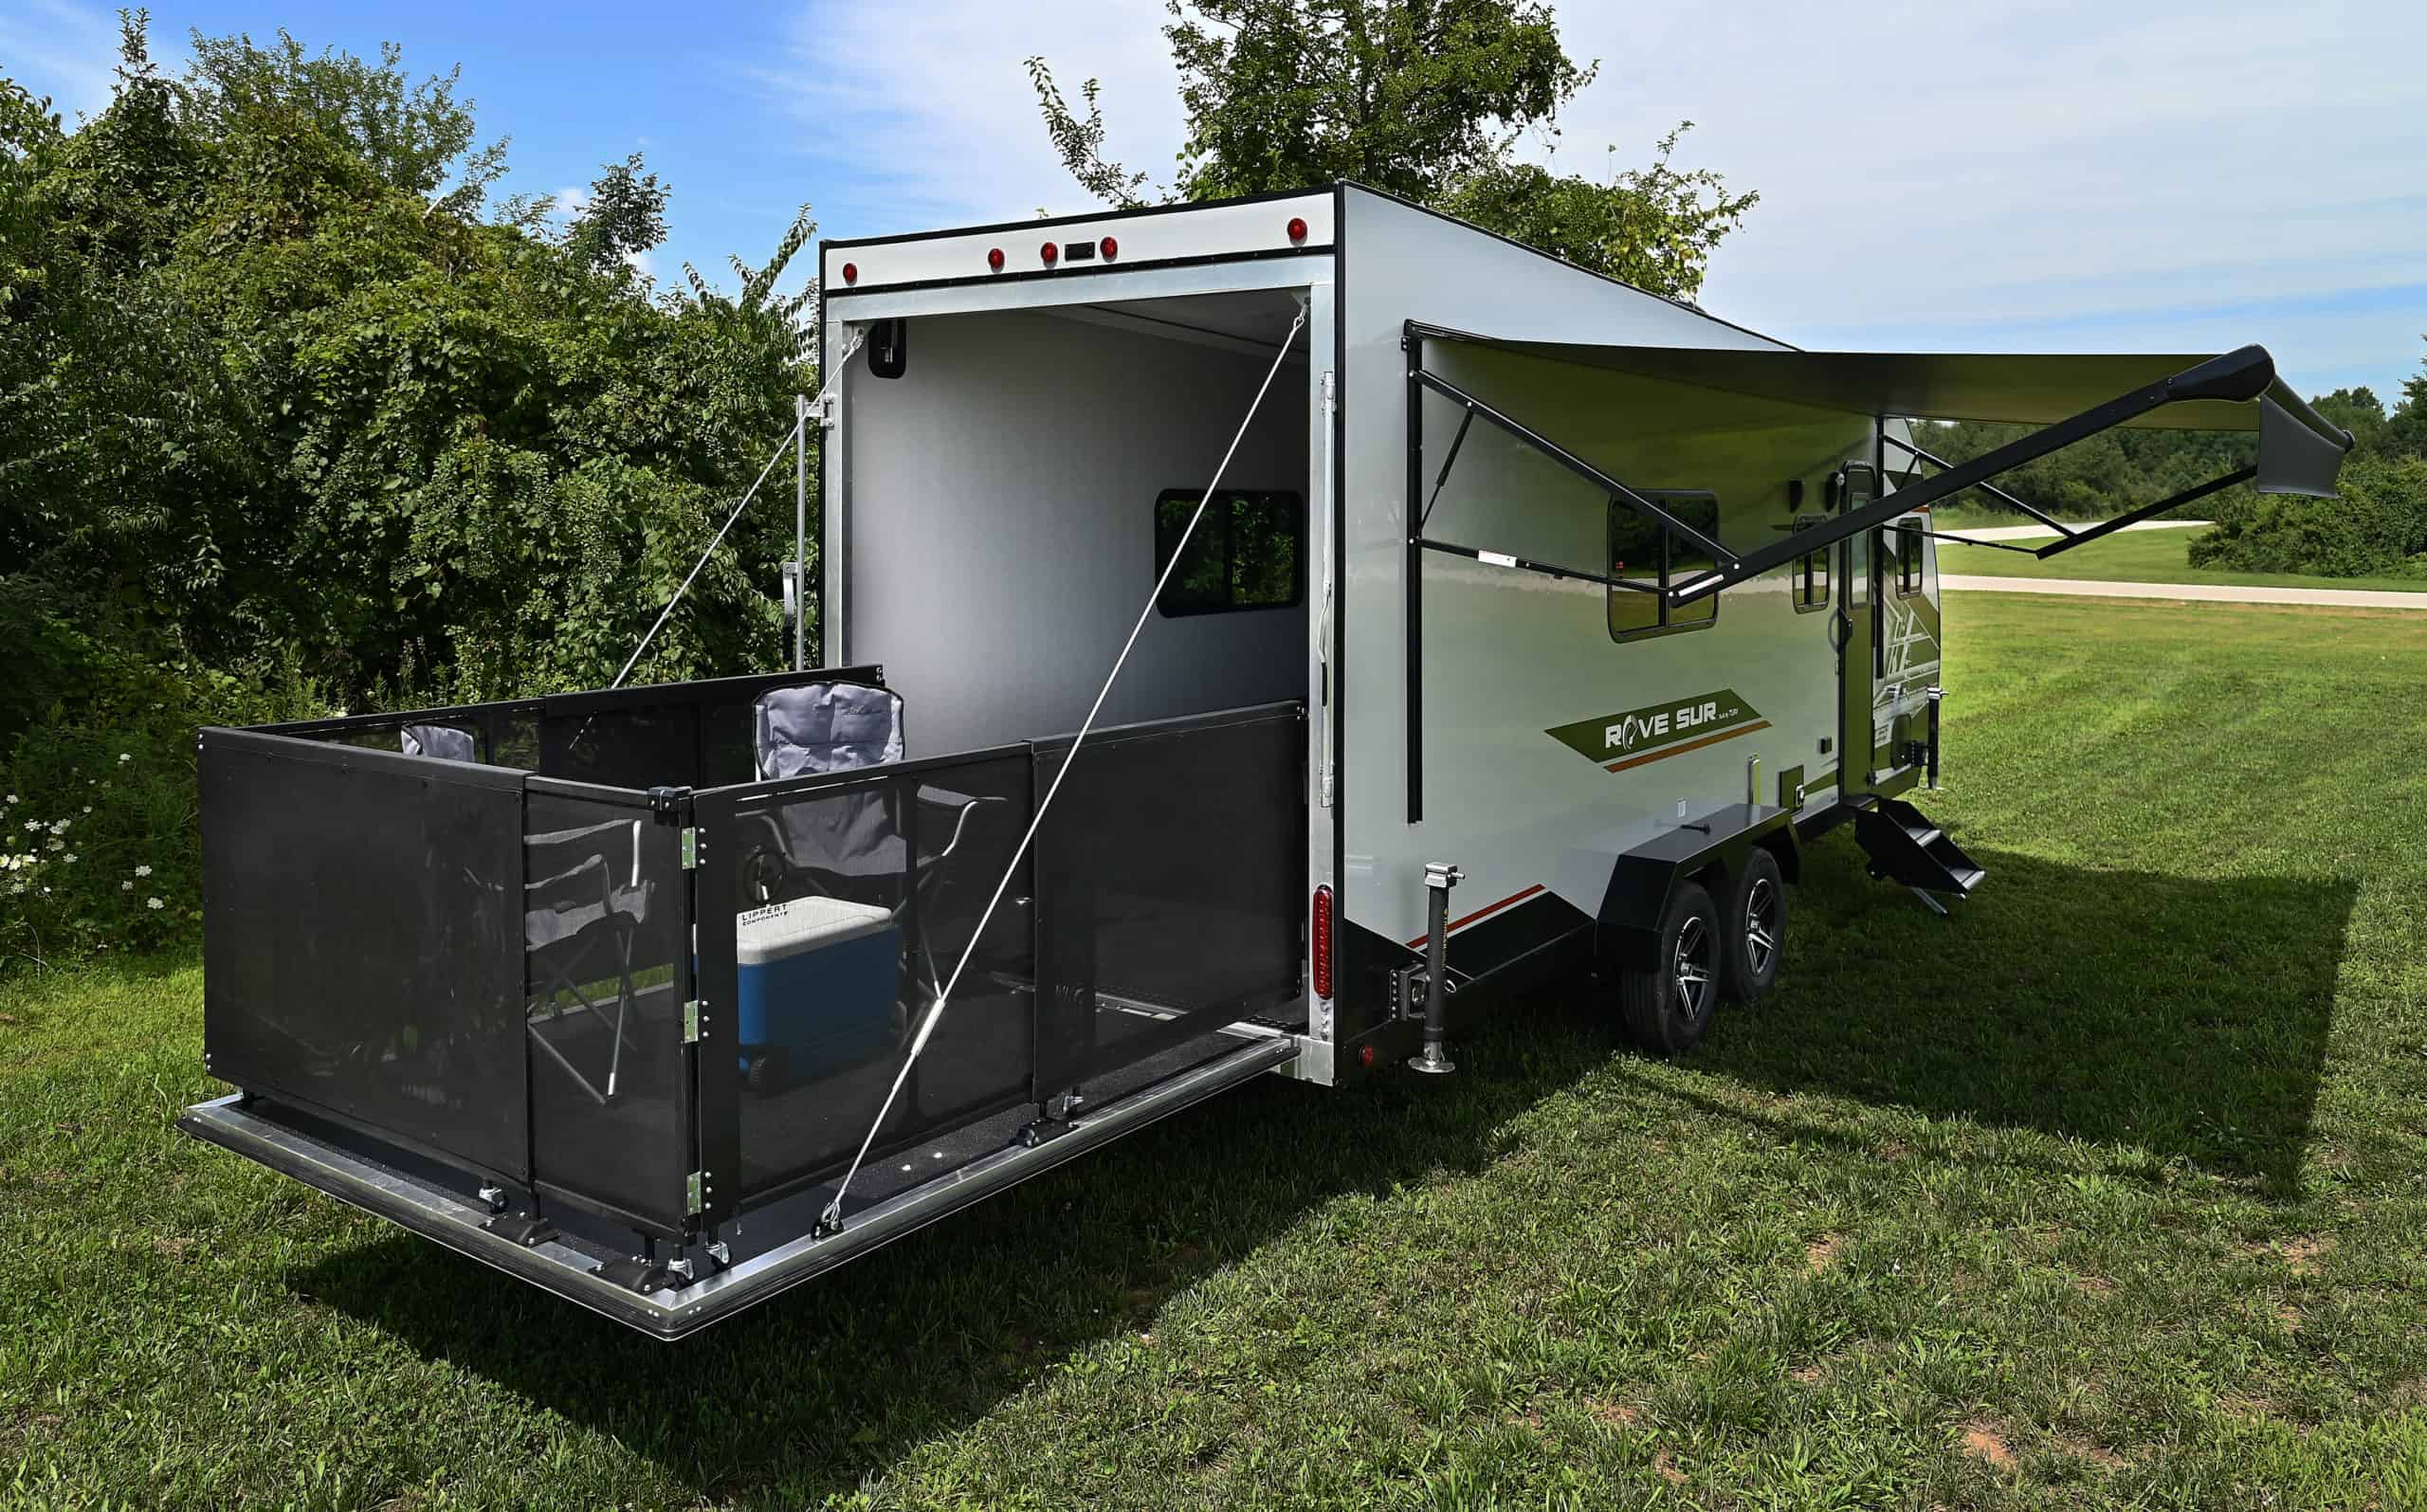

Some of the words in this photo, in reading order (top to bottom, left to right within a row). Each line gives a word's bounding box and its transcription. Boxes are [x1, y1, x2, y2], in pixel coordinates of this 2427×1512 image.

[1605, 713, 1670, 750] ROVE
[1676, 701, 1717, 730] SUR
[742, 903, 788, 920] LIPPERT
